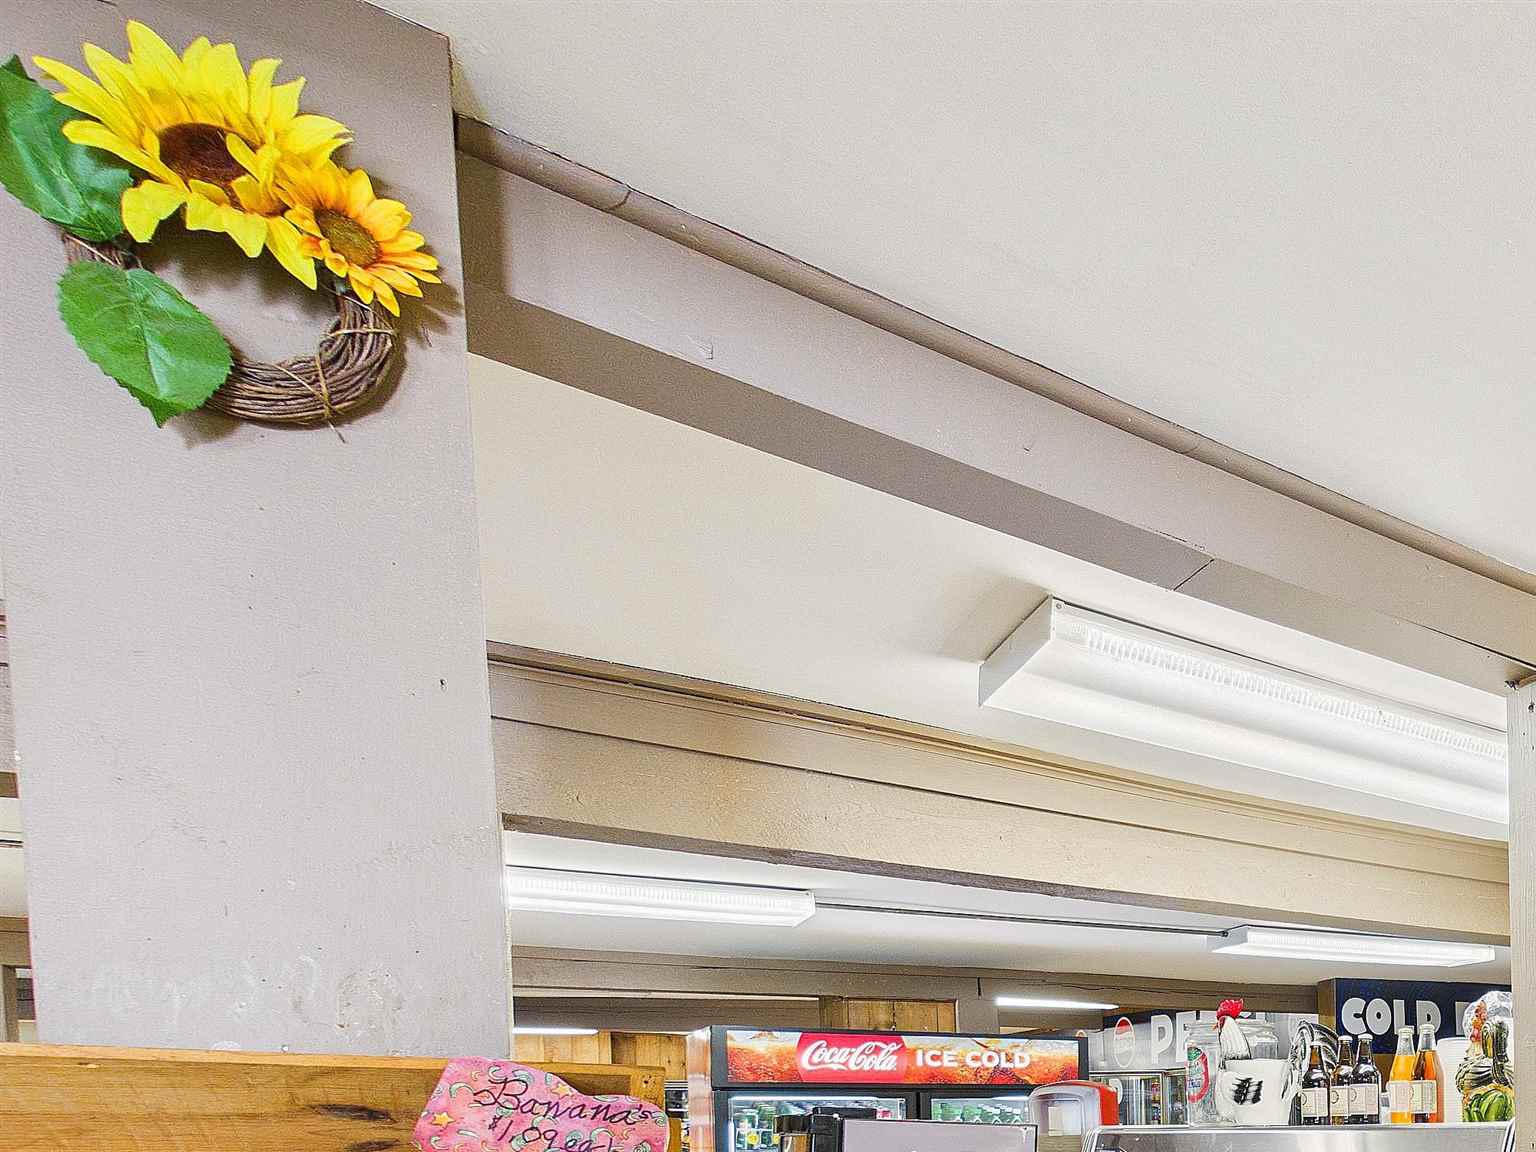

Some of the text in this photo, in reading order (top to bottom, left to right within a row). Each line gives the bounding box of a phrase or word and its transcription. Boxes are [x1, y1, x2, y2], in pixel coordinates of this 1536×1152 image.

[1341, 997, 1442, 1035] COLD
[801, 1040, 1031, 1071] Coca-Cola ICE COLD
